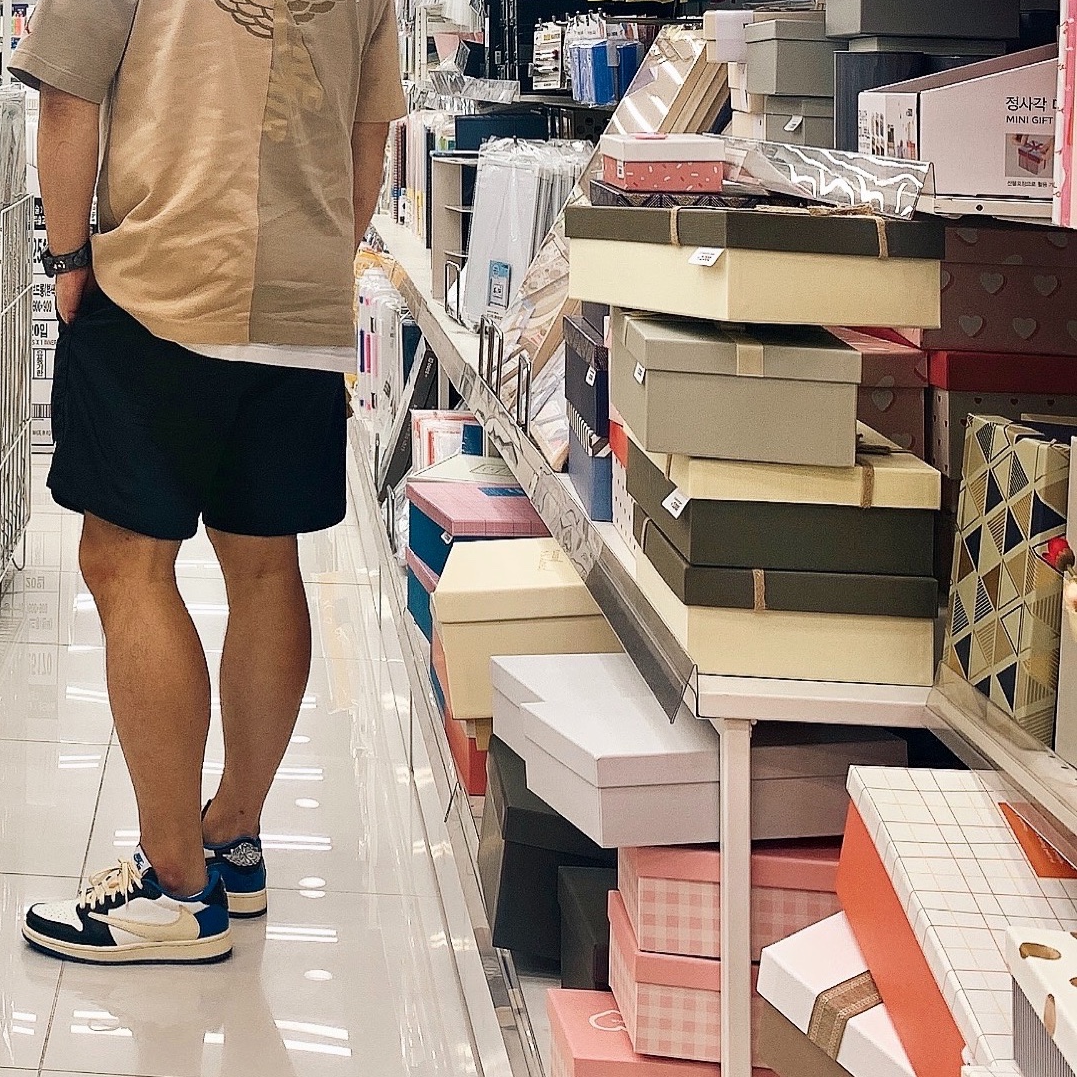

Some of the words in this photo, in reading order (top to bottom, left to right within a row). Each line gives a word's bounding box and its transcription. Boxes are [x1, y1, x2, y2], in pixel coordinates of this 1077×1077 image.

[1005, 96, 1048, 112] 정사각
[1006, 115, 1029, 124] MINI
[1032, 115, 1054, 125] GIFT
